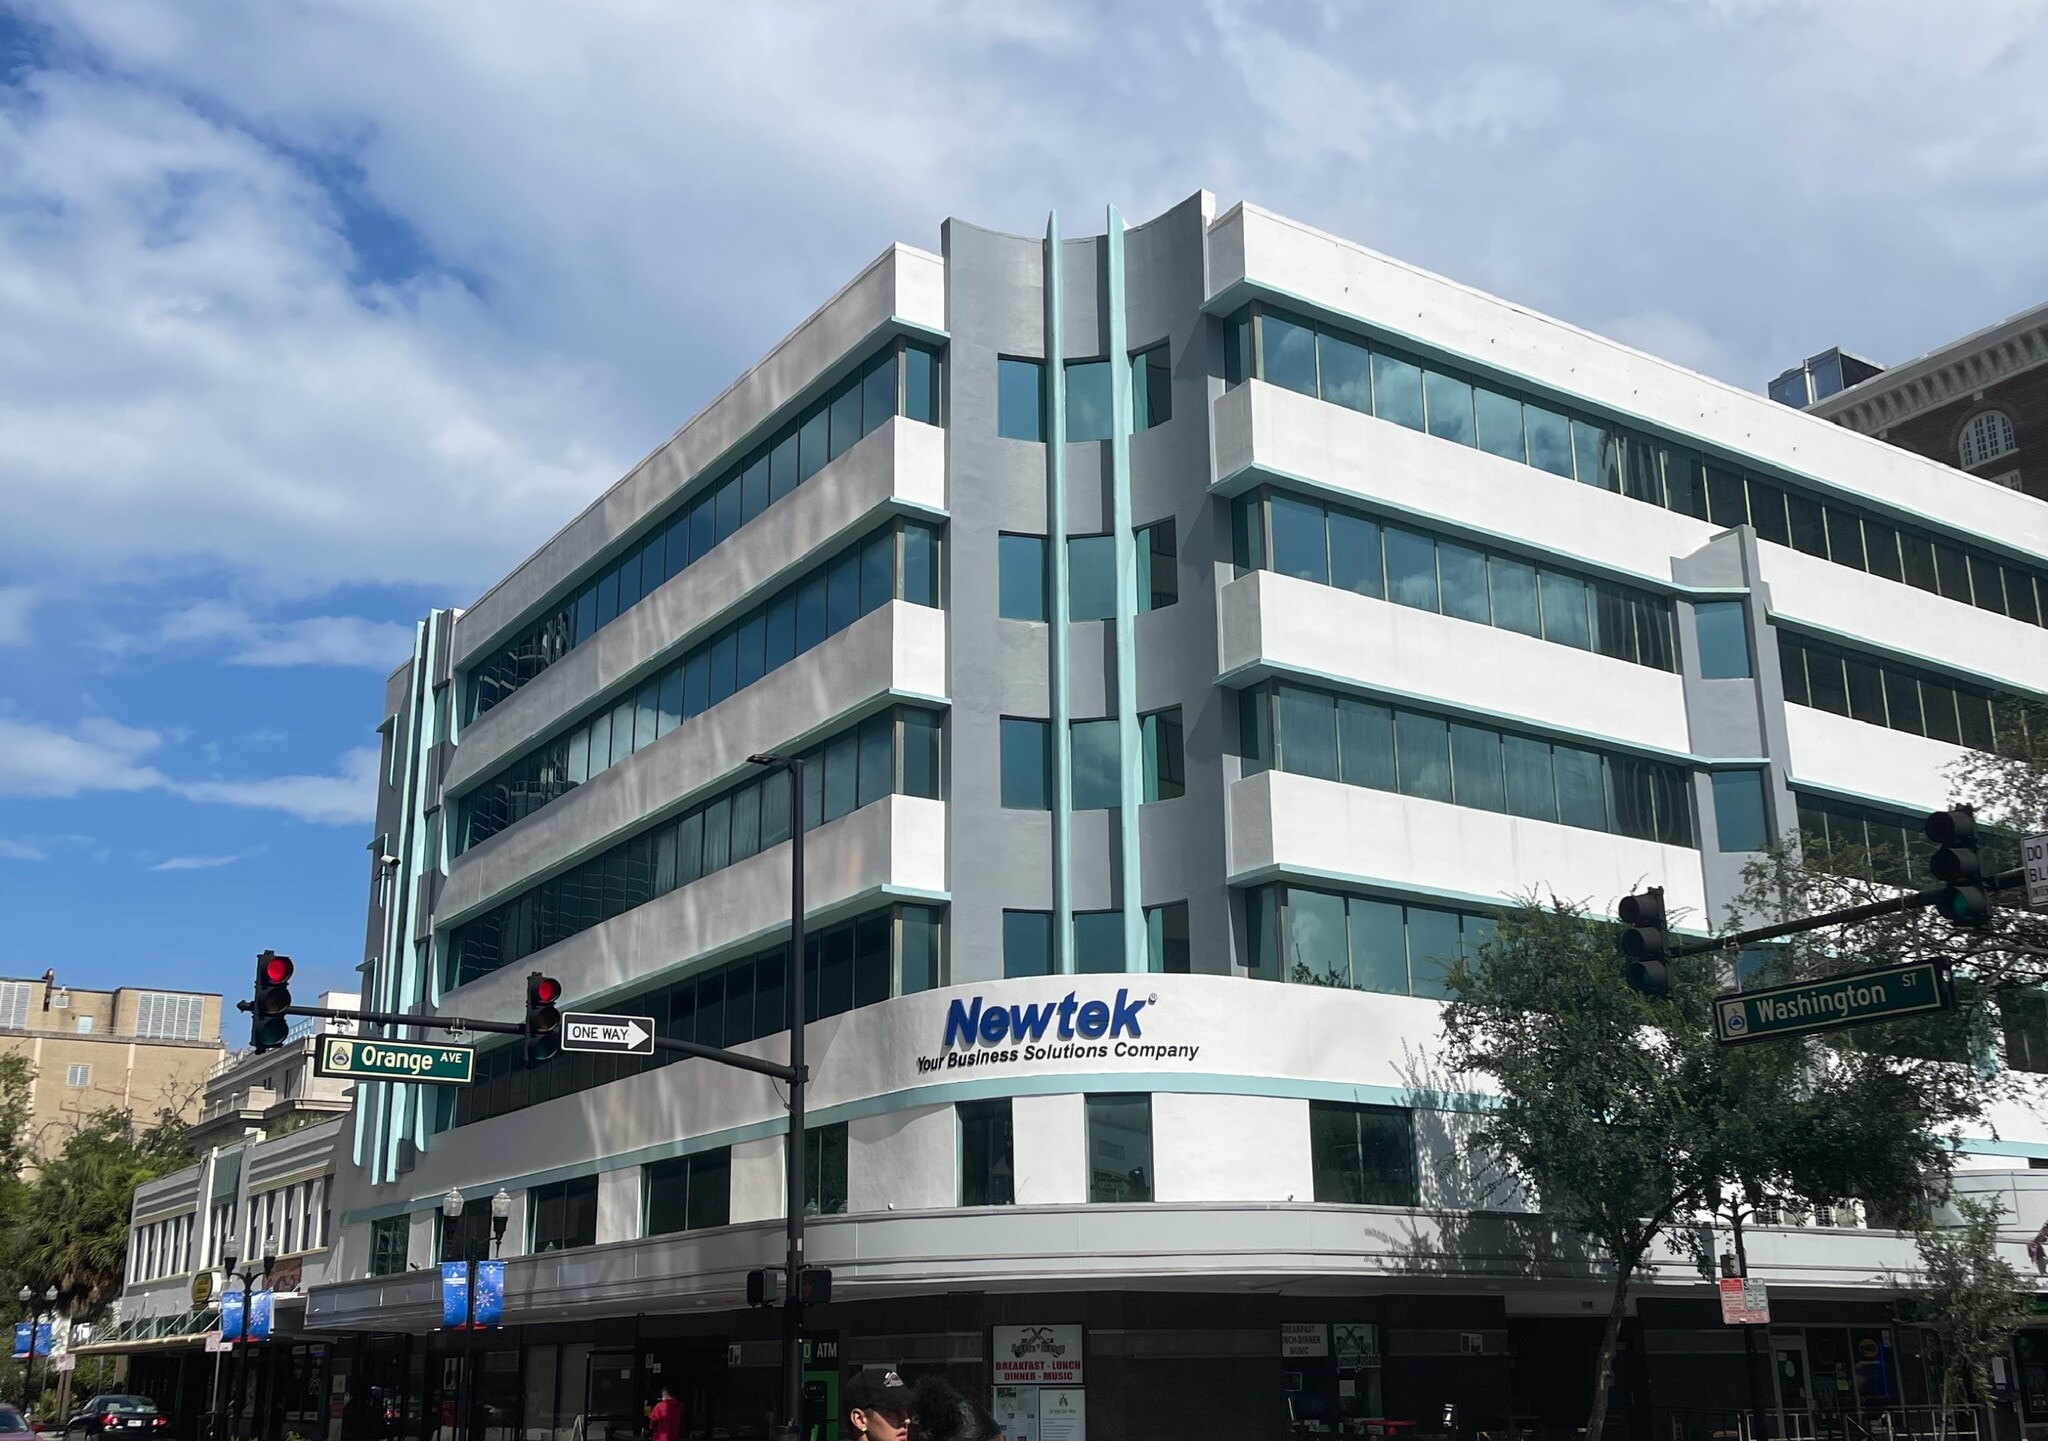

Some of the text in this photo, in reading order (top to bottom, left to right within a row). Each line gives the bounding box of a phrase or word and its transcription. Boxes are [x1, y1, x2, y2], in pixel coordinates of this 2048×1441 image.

[2027, 845, 2043, 862] DO
[2029, 867, 2048, 882] BL
[1756, 972, 1918, 1024] Washington ST
[943, 988, 1147, 1047] Newtek
[572, 1026, 629, 1041] ONE WAY
[361, 1045, 463, 1075] Orange AVE
[918, 1042, 1200, 1074] Your Business Solutions Company
[816, 1342, 837, 1358] ATM
[1289, 1346, 1309, 1355] MUSIC
[995, 1361, 1045, 1371] BREAKFAST
[1052, 1361, 1081, 1370] LUNCH
[1004, 1372, 1036, 1381] DINNER
[1043, 1372, 1073, 1381] MUSIC
